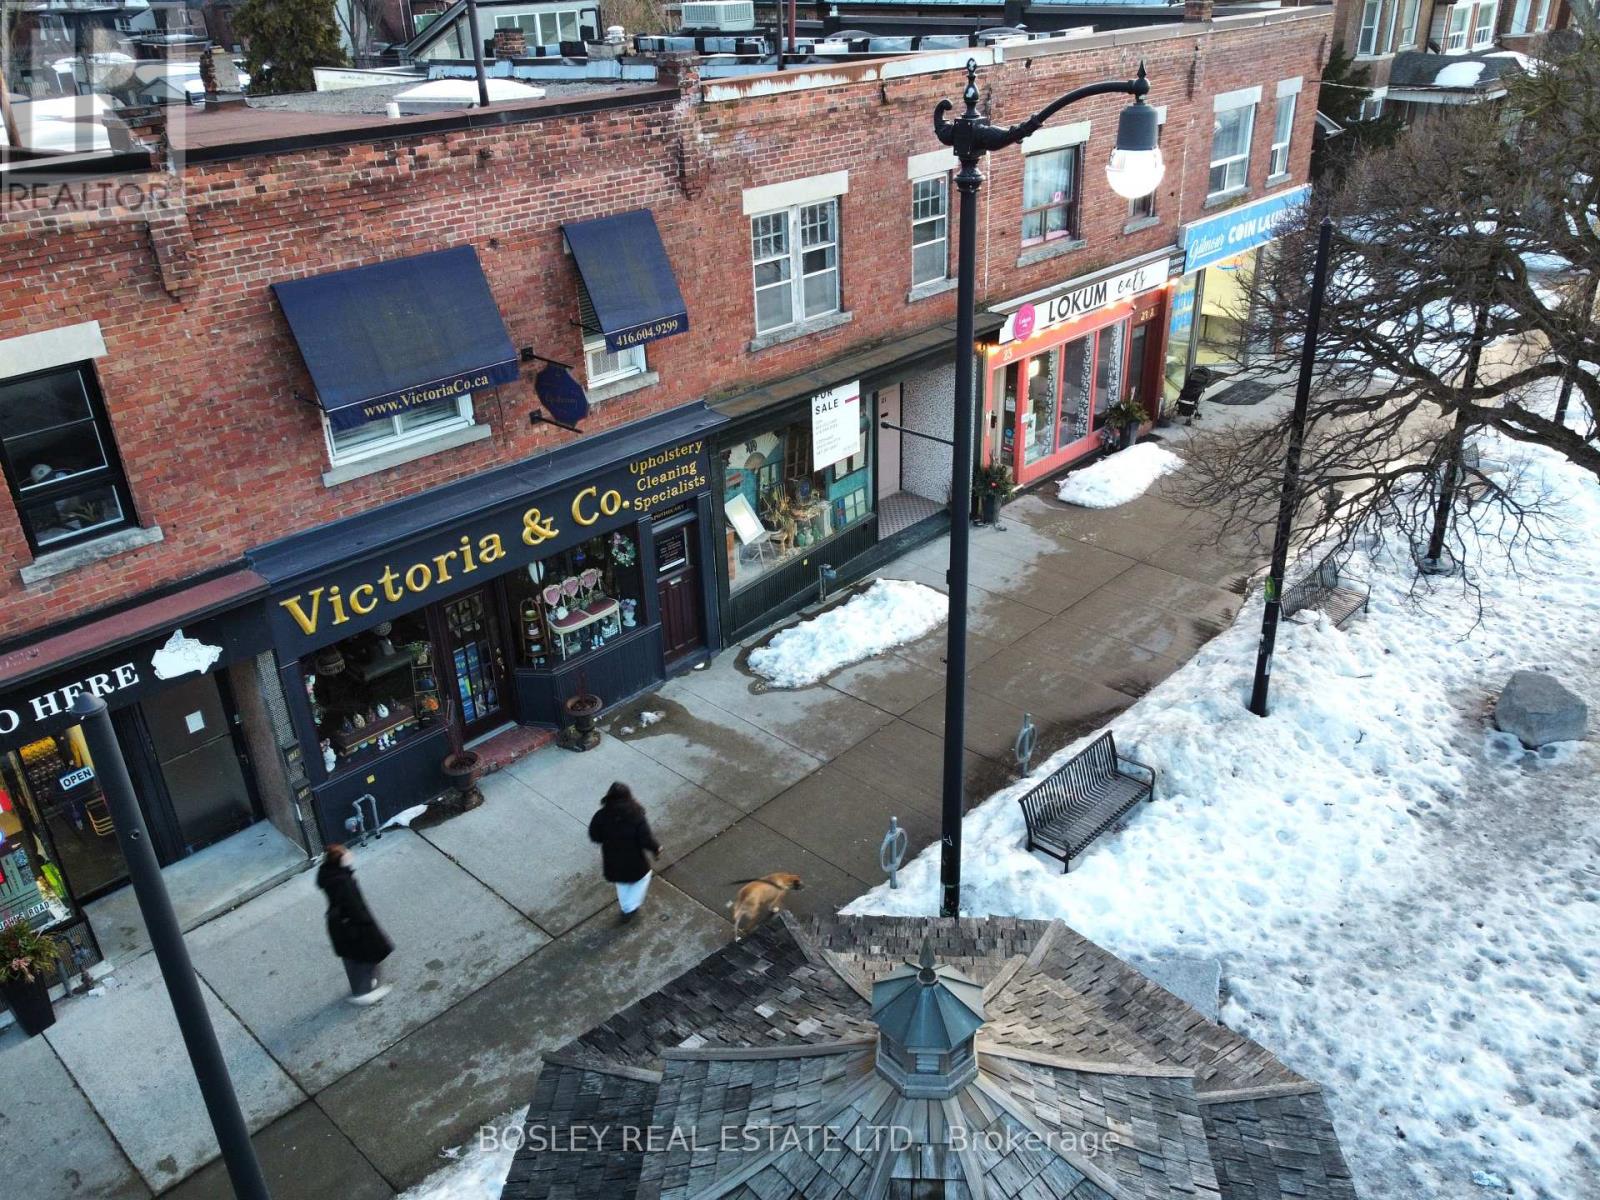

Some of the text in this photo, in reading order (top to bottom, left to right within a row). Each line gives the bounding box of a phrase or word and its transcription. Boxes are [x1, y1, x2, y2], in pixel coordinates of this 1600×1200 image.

[1228, 222, 1256, 243] COIN
[1048, 268, 1147, 323] LOKUM eats
[616, 319, 678, 347] 416.604.9299
[364, 374, 489, 417] www.VictoriaCo.ca
[815, 398, 839, 415] SALE
[630, 440, 703, 476] Upholstery
[636, 460, 697, 491] Cleaning
[634, 475, 706, 512] Specialists
[279, 485, 631, 636] Victoria & Co.
[63, 768, 92, 788] OPEN
[28, 900, 50, 918] ROAD
